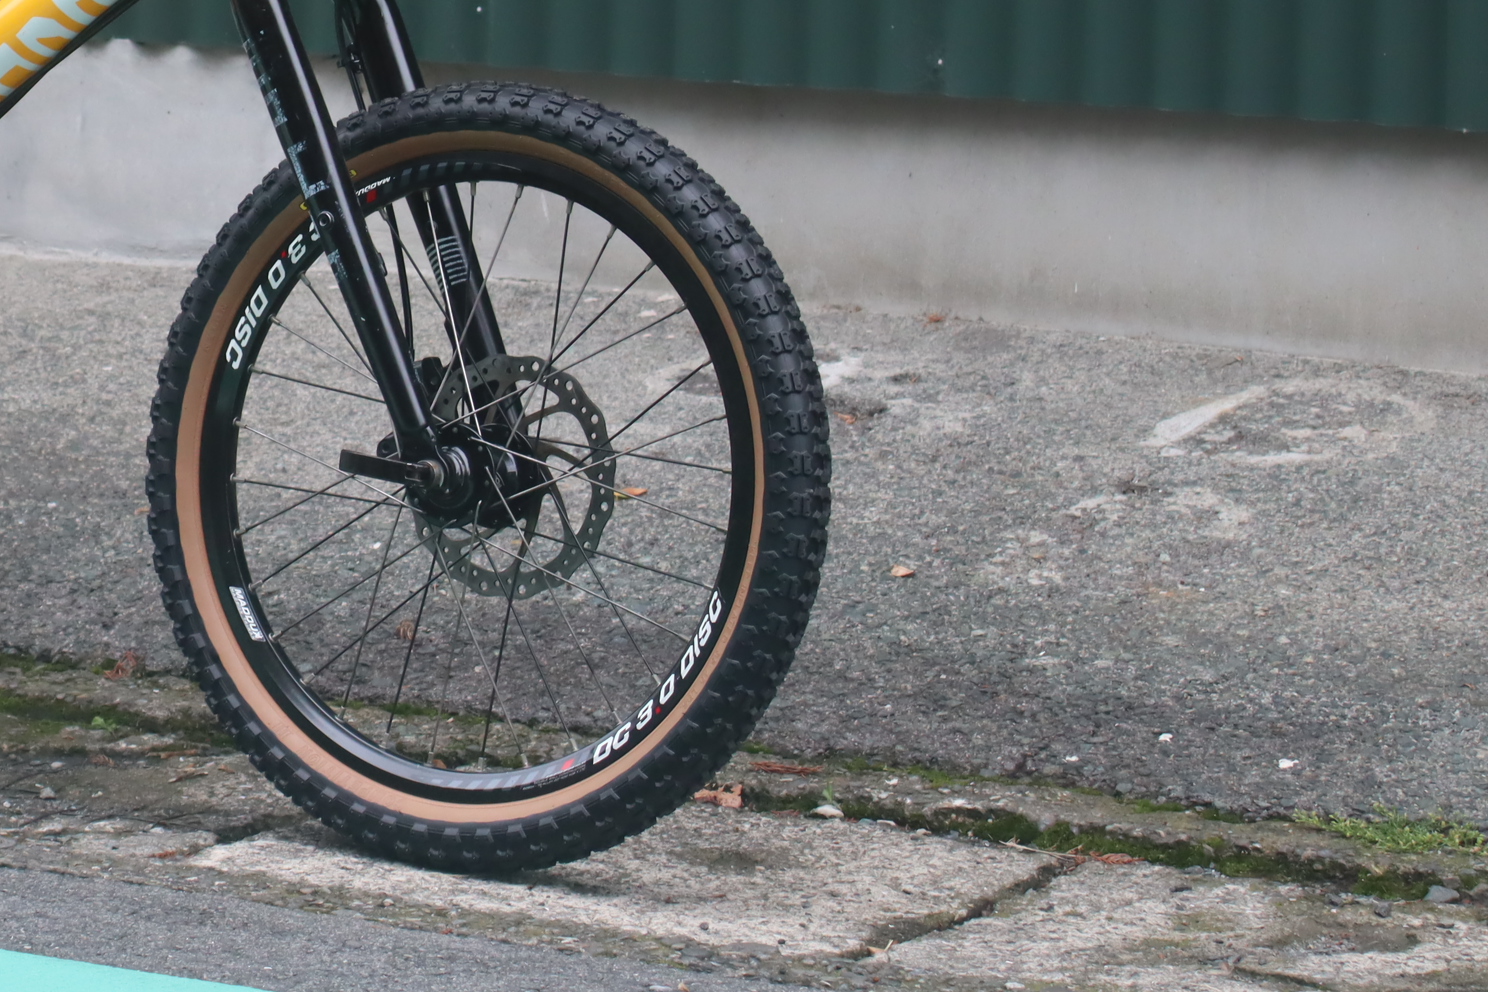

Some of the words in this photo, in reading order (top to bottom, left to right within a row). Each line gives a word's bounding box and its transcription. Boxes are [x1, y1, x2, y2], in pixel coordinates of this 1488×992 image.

[226, 285, 269, 369] DISC
[593, 722, 632, 765] DC
[636, 673, 675, 730] 3.0
[680, 591, 722, 679] DISC
